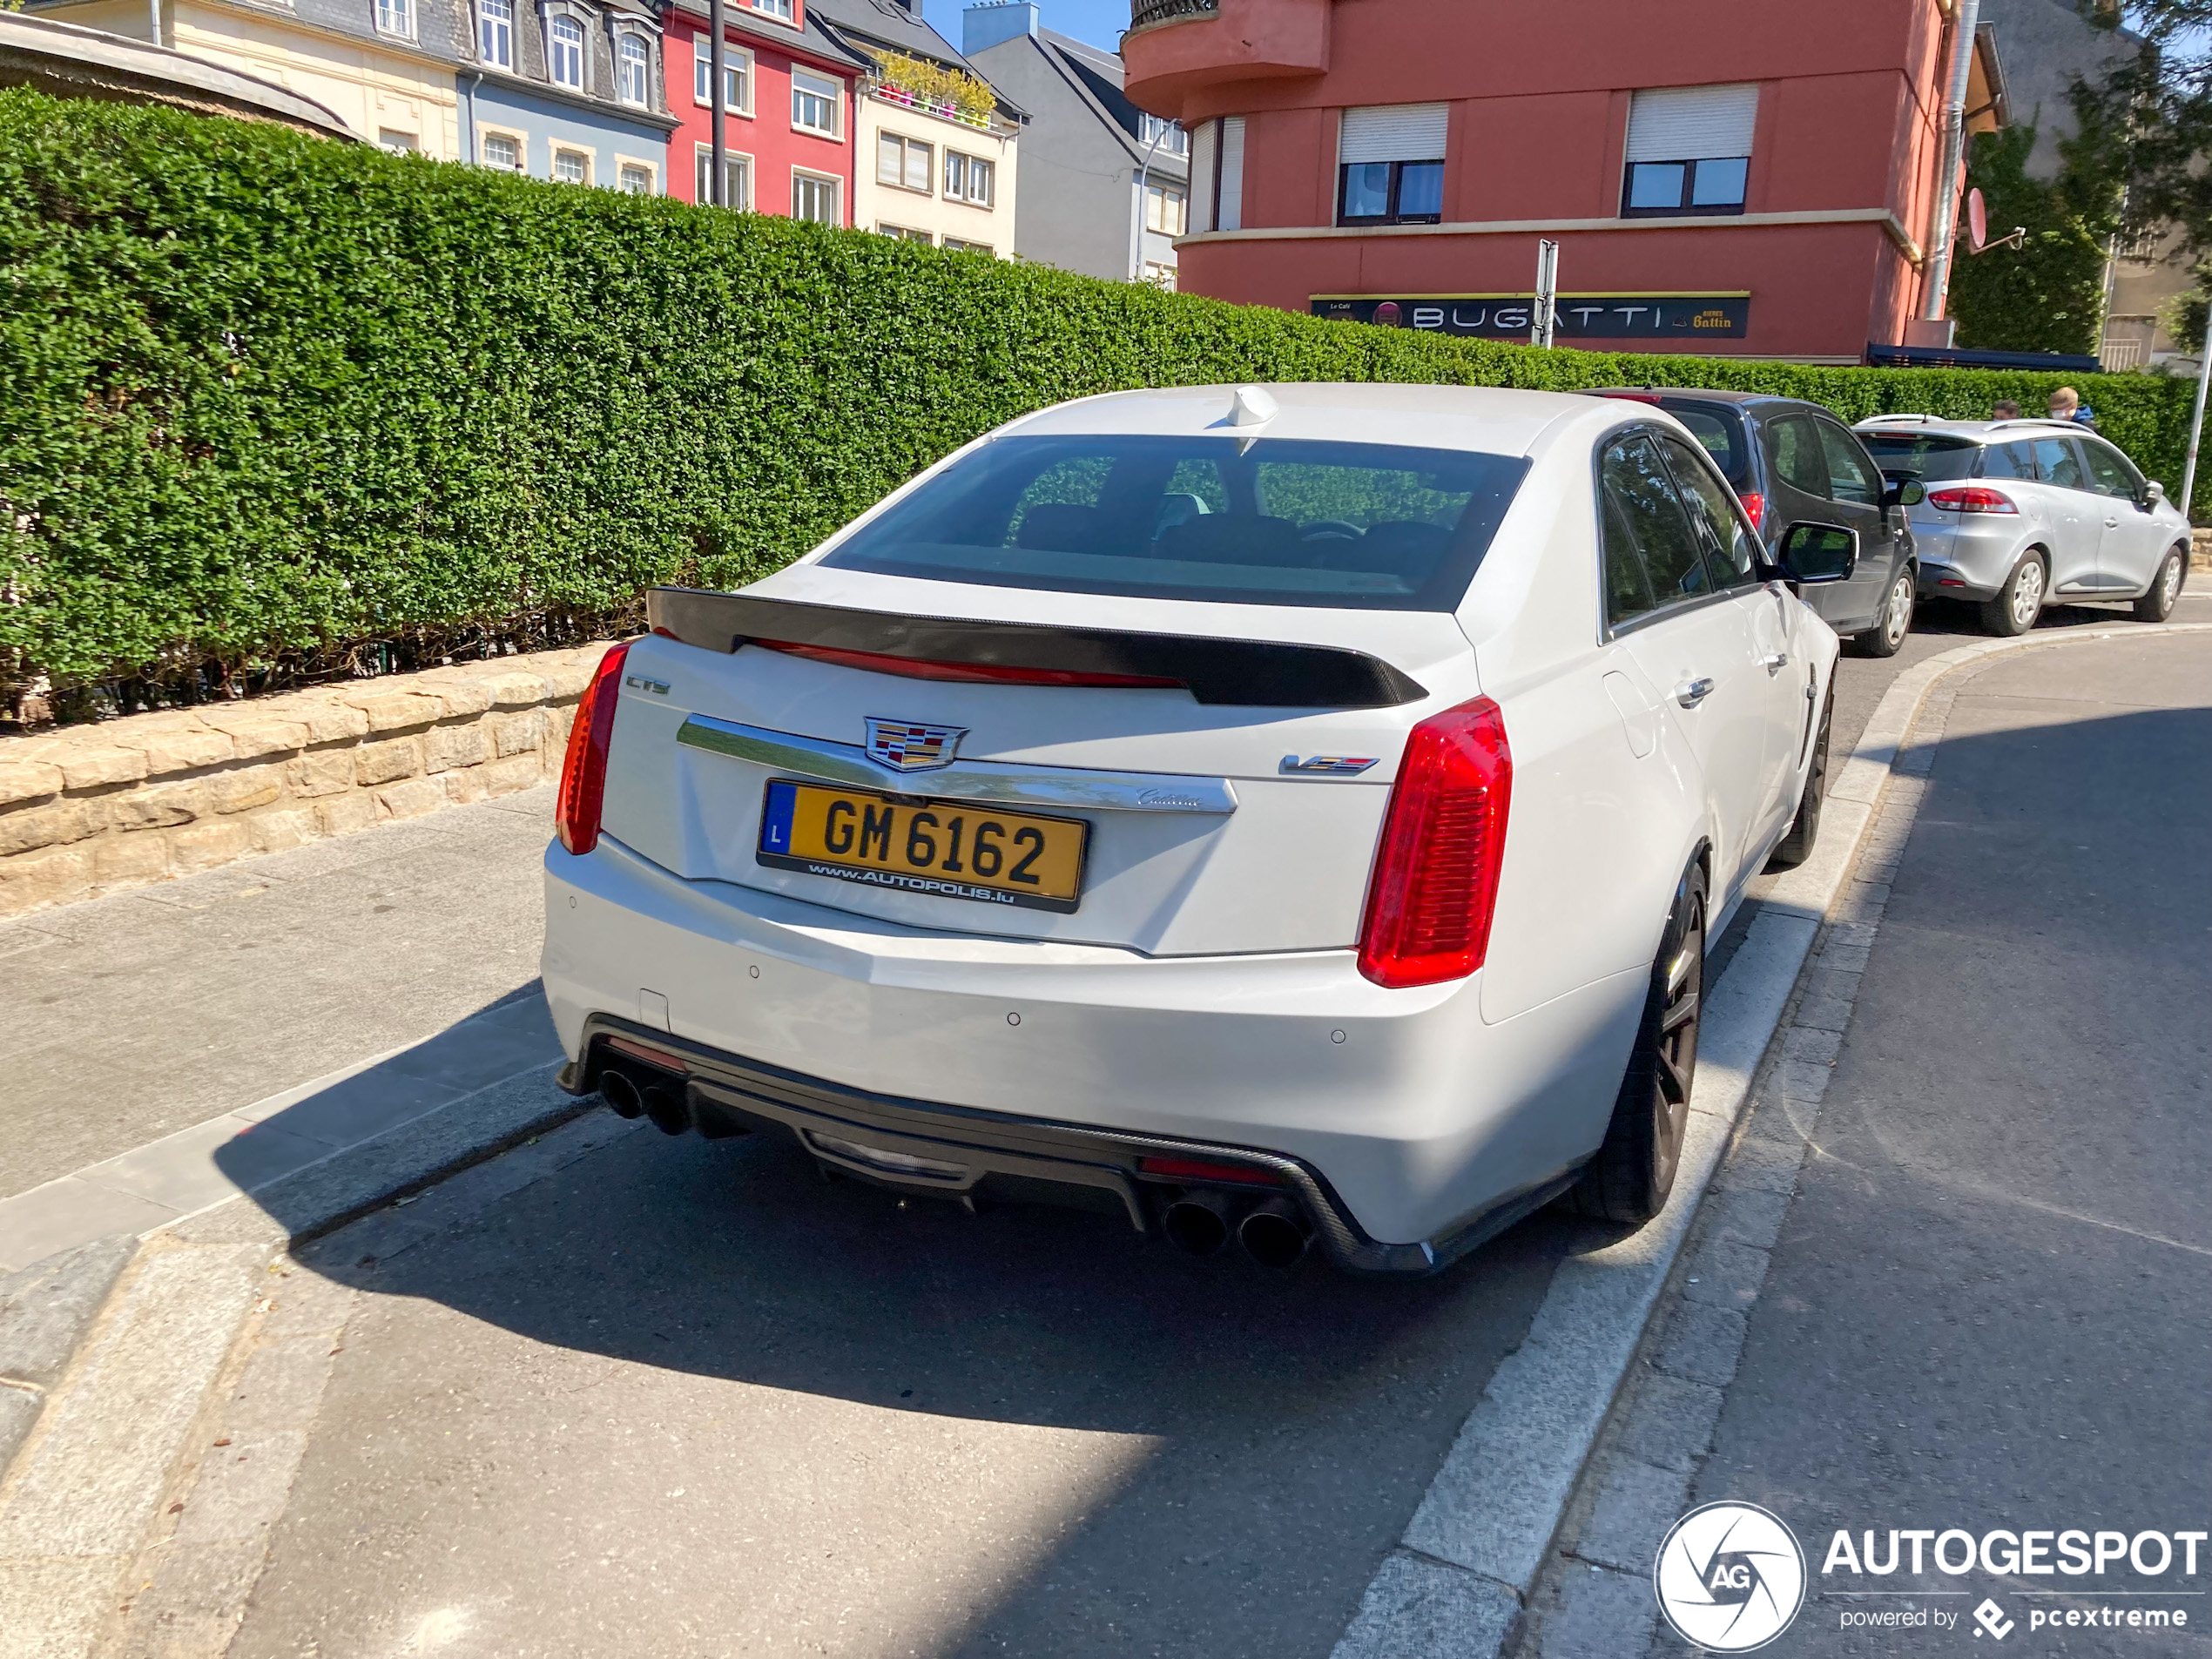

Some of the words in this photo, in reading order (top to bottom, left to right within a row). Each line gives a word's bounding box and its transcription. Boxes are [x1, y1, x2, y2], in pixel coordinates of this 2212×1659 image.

[1413, 307, 1661, 328] BUGTTI
[626, 675, 671, 696] CTS
[1136, 787, 1204, 806] Cadillac
[771, 825, 781, 844] L
[824, 800, 894, 860] GM
[906, 812, 1044, 886] 6162
[808, 864, 1015, 904] www.AUTOPOLIS.lu
